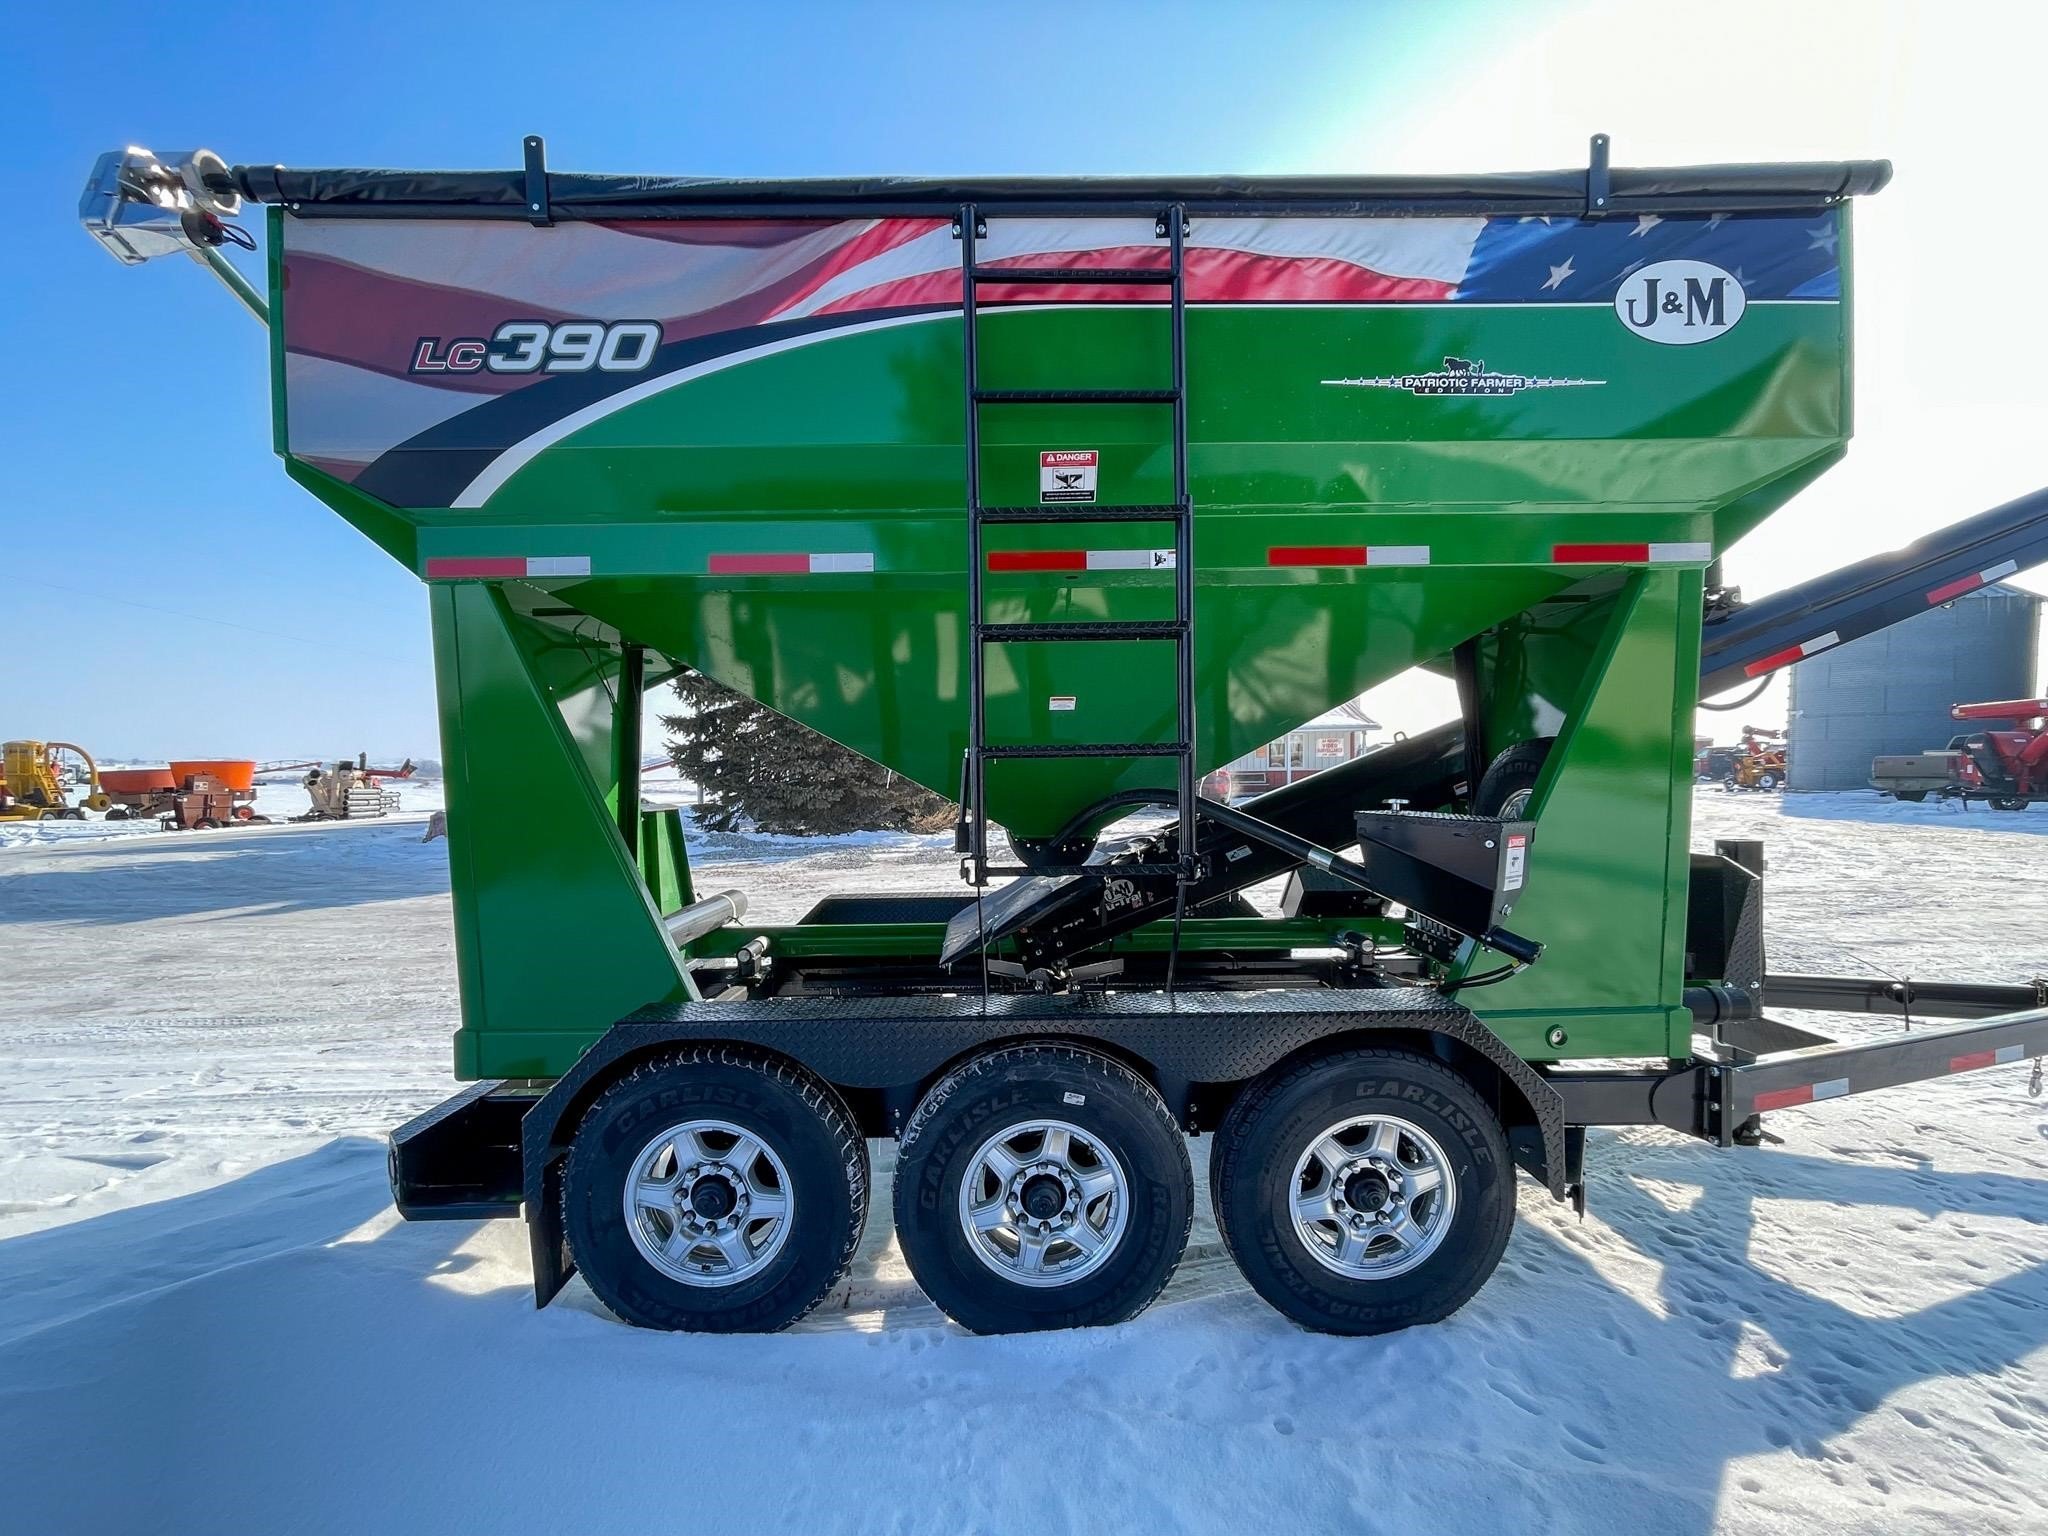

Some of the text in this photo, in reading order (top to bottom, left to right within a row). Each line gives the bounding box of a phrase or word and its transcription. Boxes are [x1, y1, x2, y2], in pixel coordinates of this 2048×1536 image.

[1625, 277, 1727, 327] J&M
[1404, 378, 1522, 388] PATRIOTIC FARMER
[1056, 453, 1093, 461] DANGER
[616, 1085, 772, 1134] CARLISLE
[1355, 1080, 1494, 1167] CARLISLE
[919, 1088, 1031, 1210] CARLISLE
